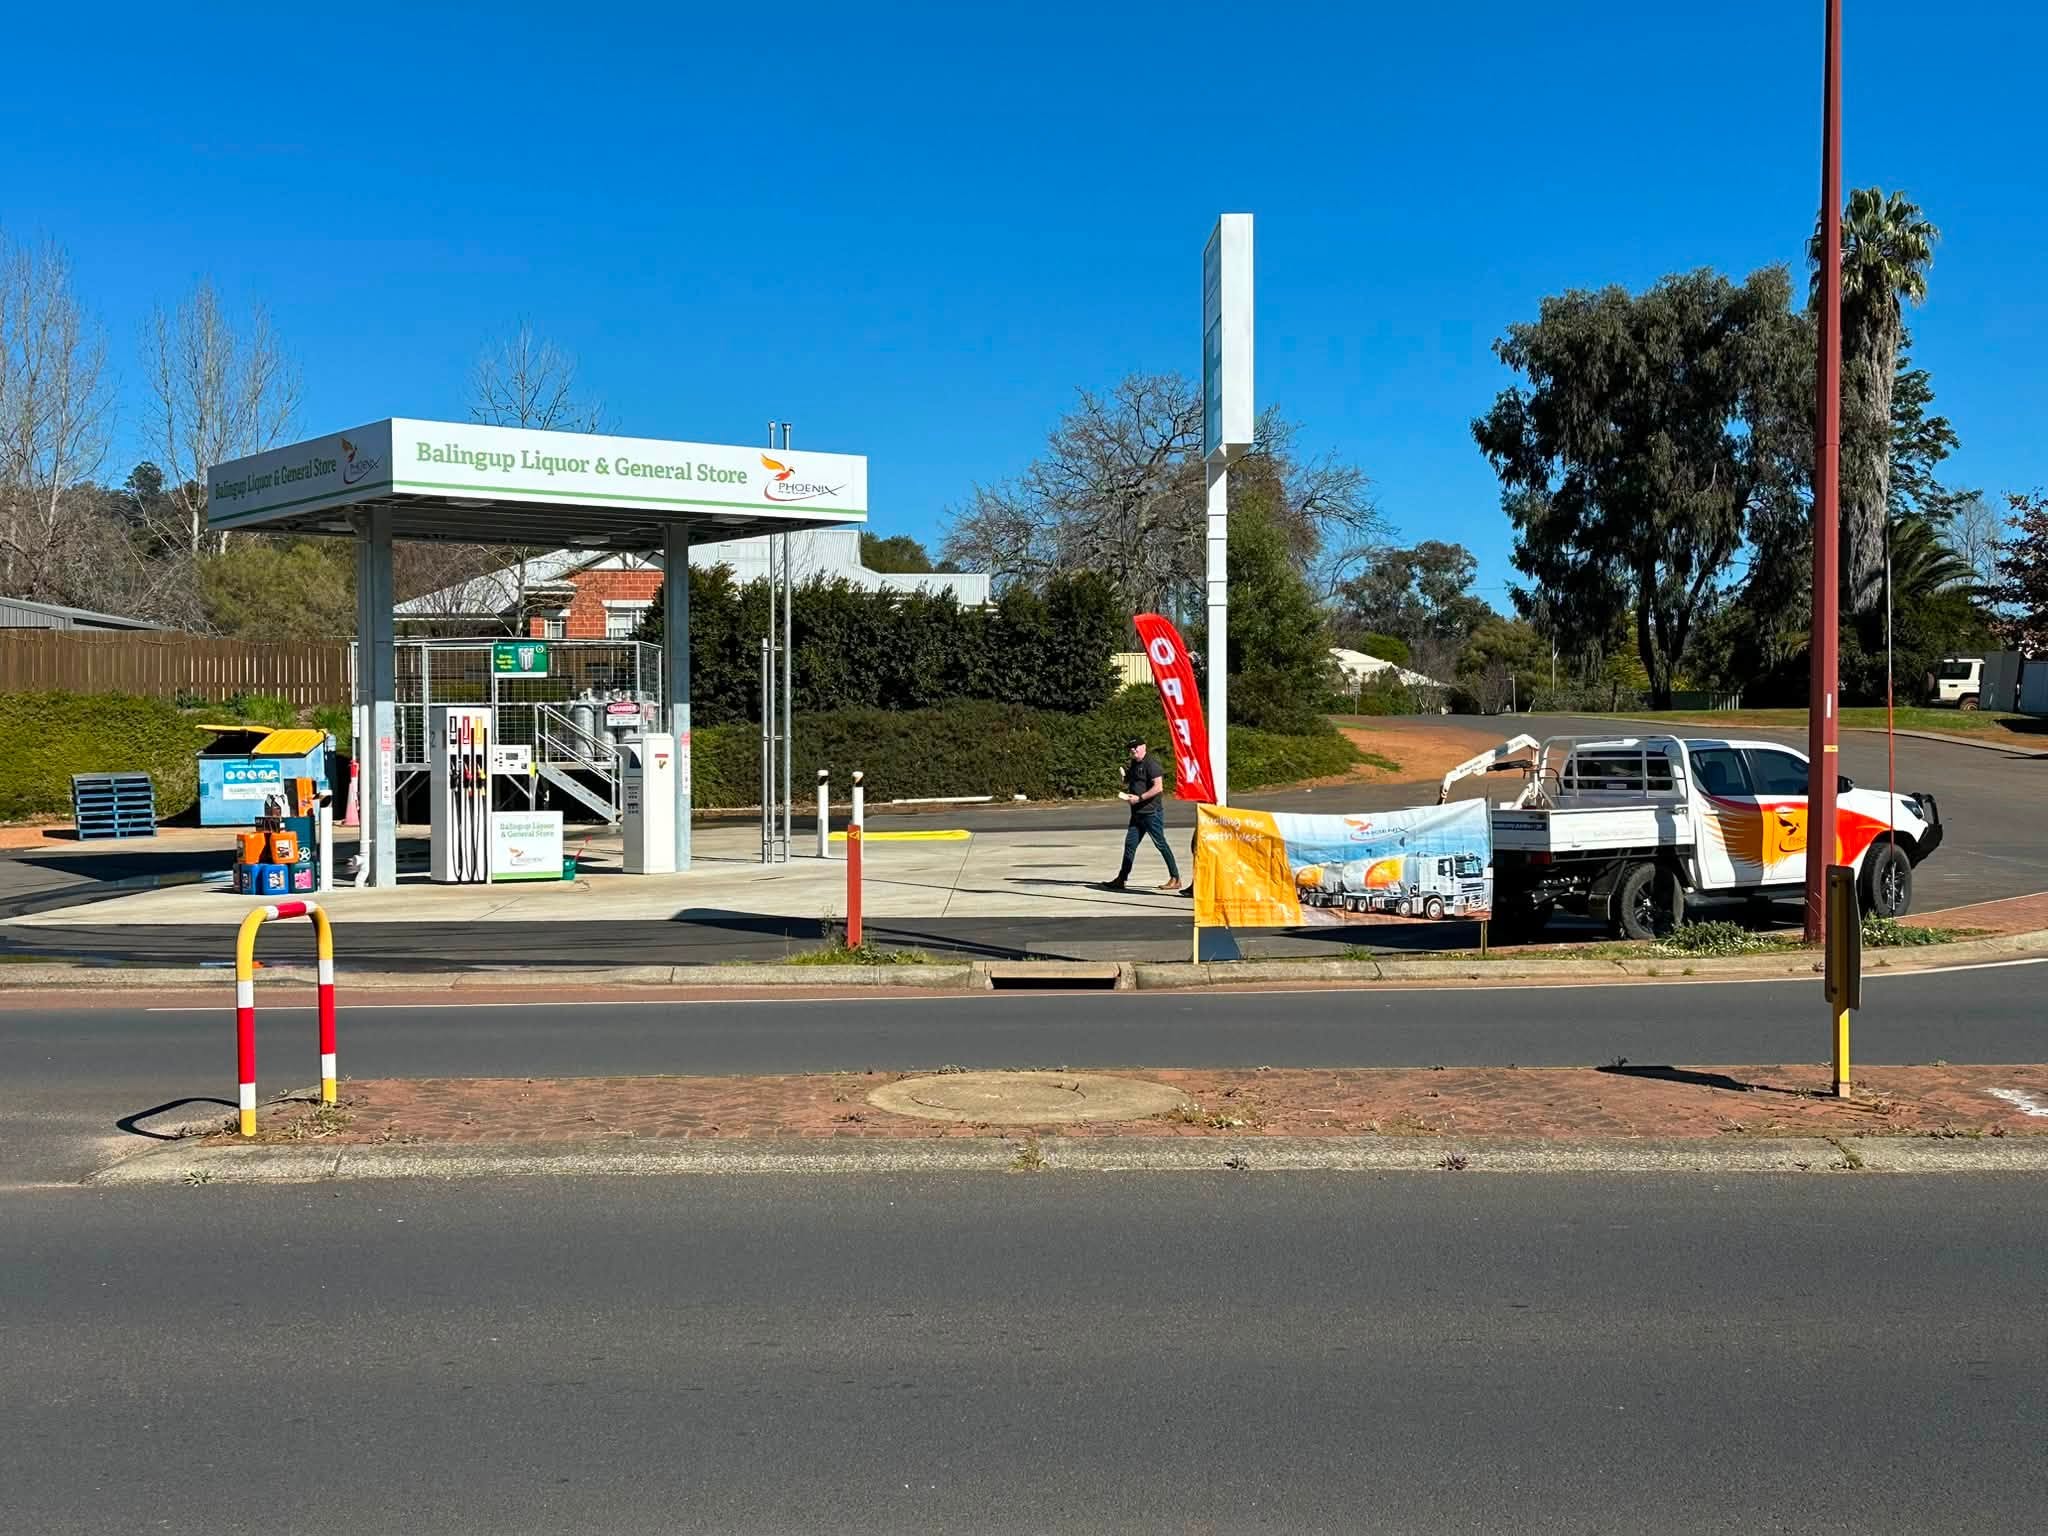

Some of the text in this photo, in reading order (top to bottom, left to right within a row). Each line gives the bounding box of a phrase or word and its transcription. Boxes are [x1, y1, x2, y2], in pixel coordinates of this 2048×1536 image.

[416, 442, 748, 484] Balingup Liquor & General Store
[215, 456, 337, 500] Balingup Liquor & General Store
[778, 482, 846, 496] PHOENIX
[1200, 815, 1241, 831] uelling
